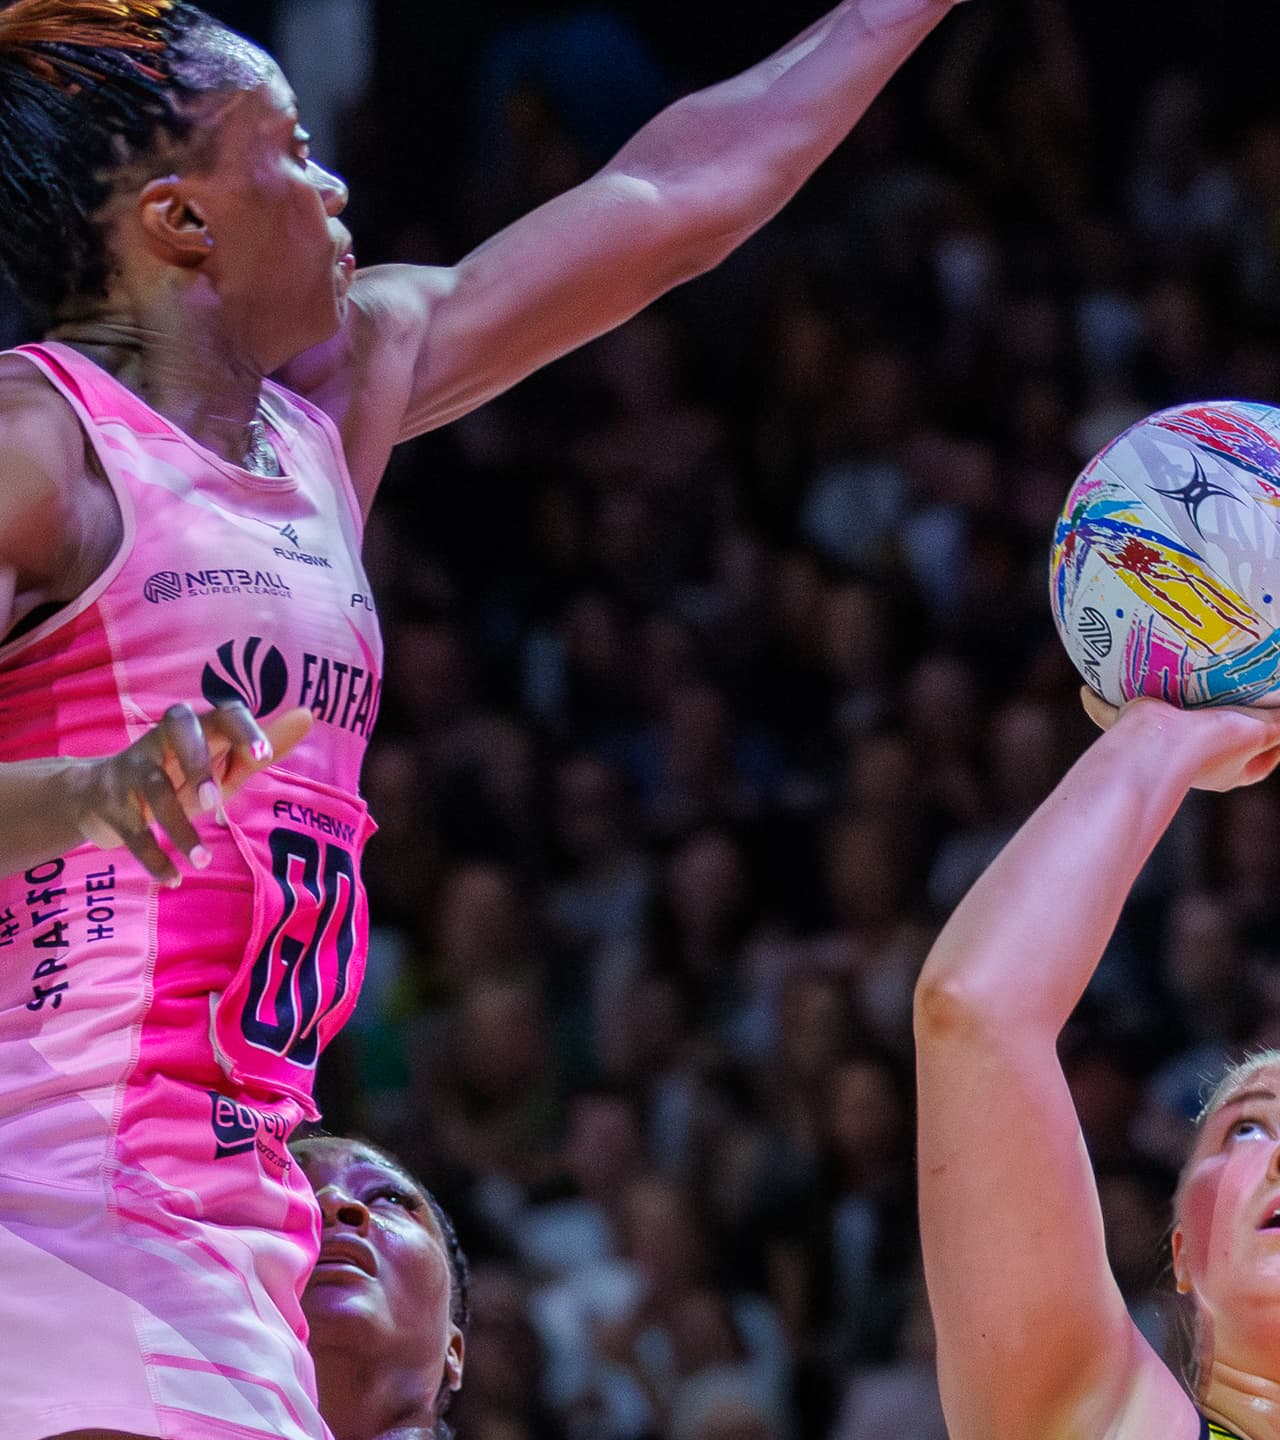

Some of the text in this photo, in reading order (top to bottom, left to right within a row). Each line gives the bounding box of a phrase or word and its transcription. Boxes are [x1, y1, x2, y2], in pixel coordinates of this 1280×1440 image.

[185, 569, 290, 591] NETBALL
[188, 587, 241, 597] SUPER
[86, 864, 116, 942] HOTEL
